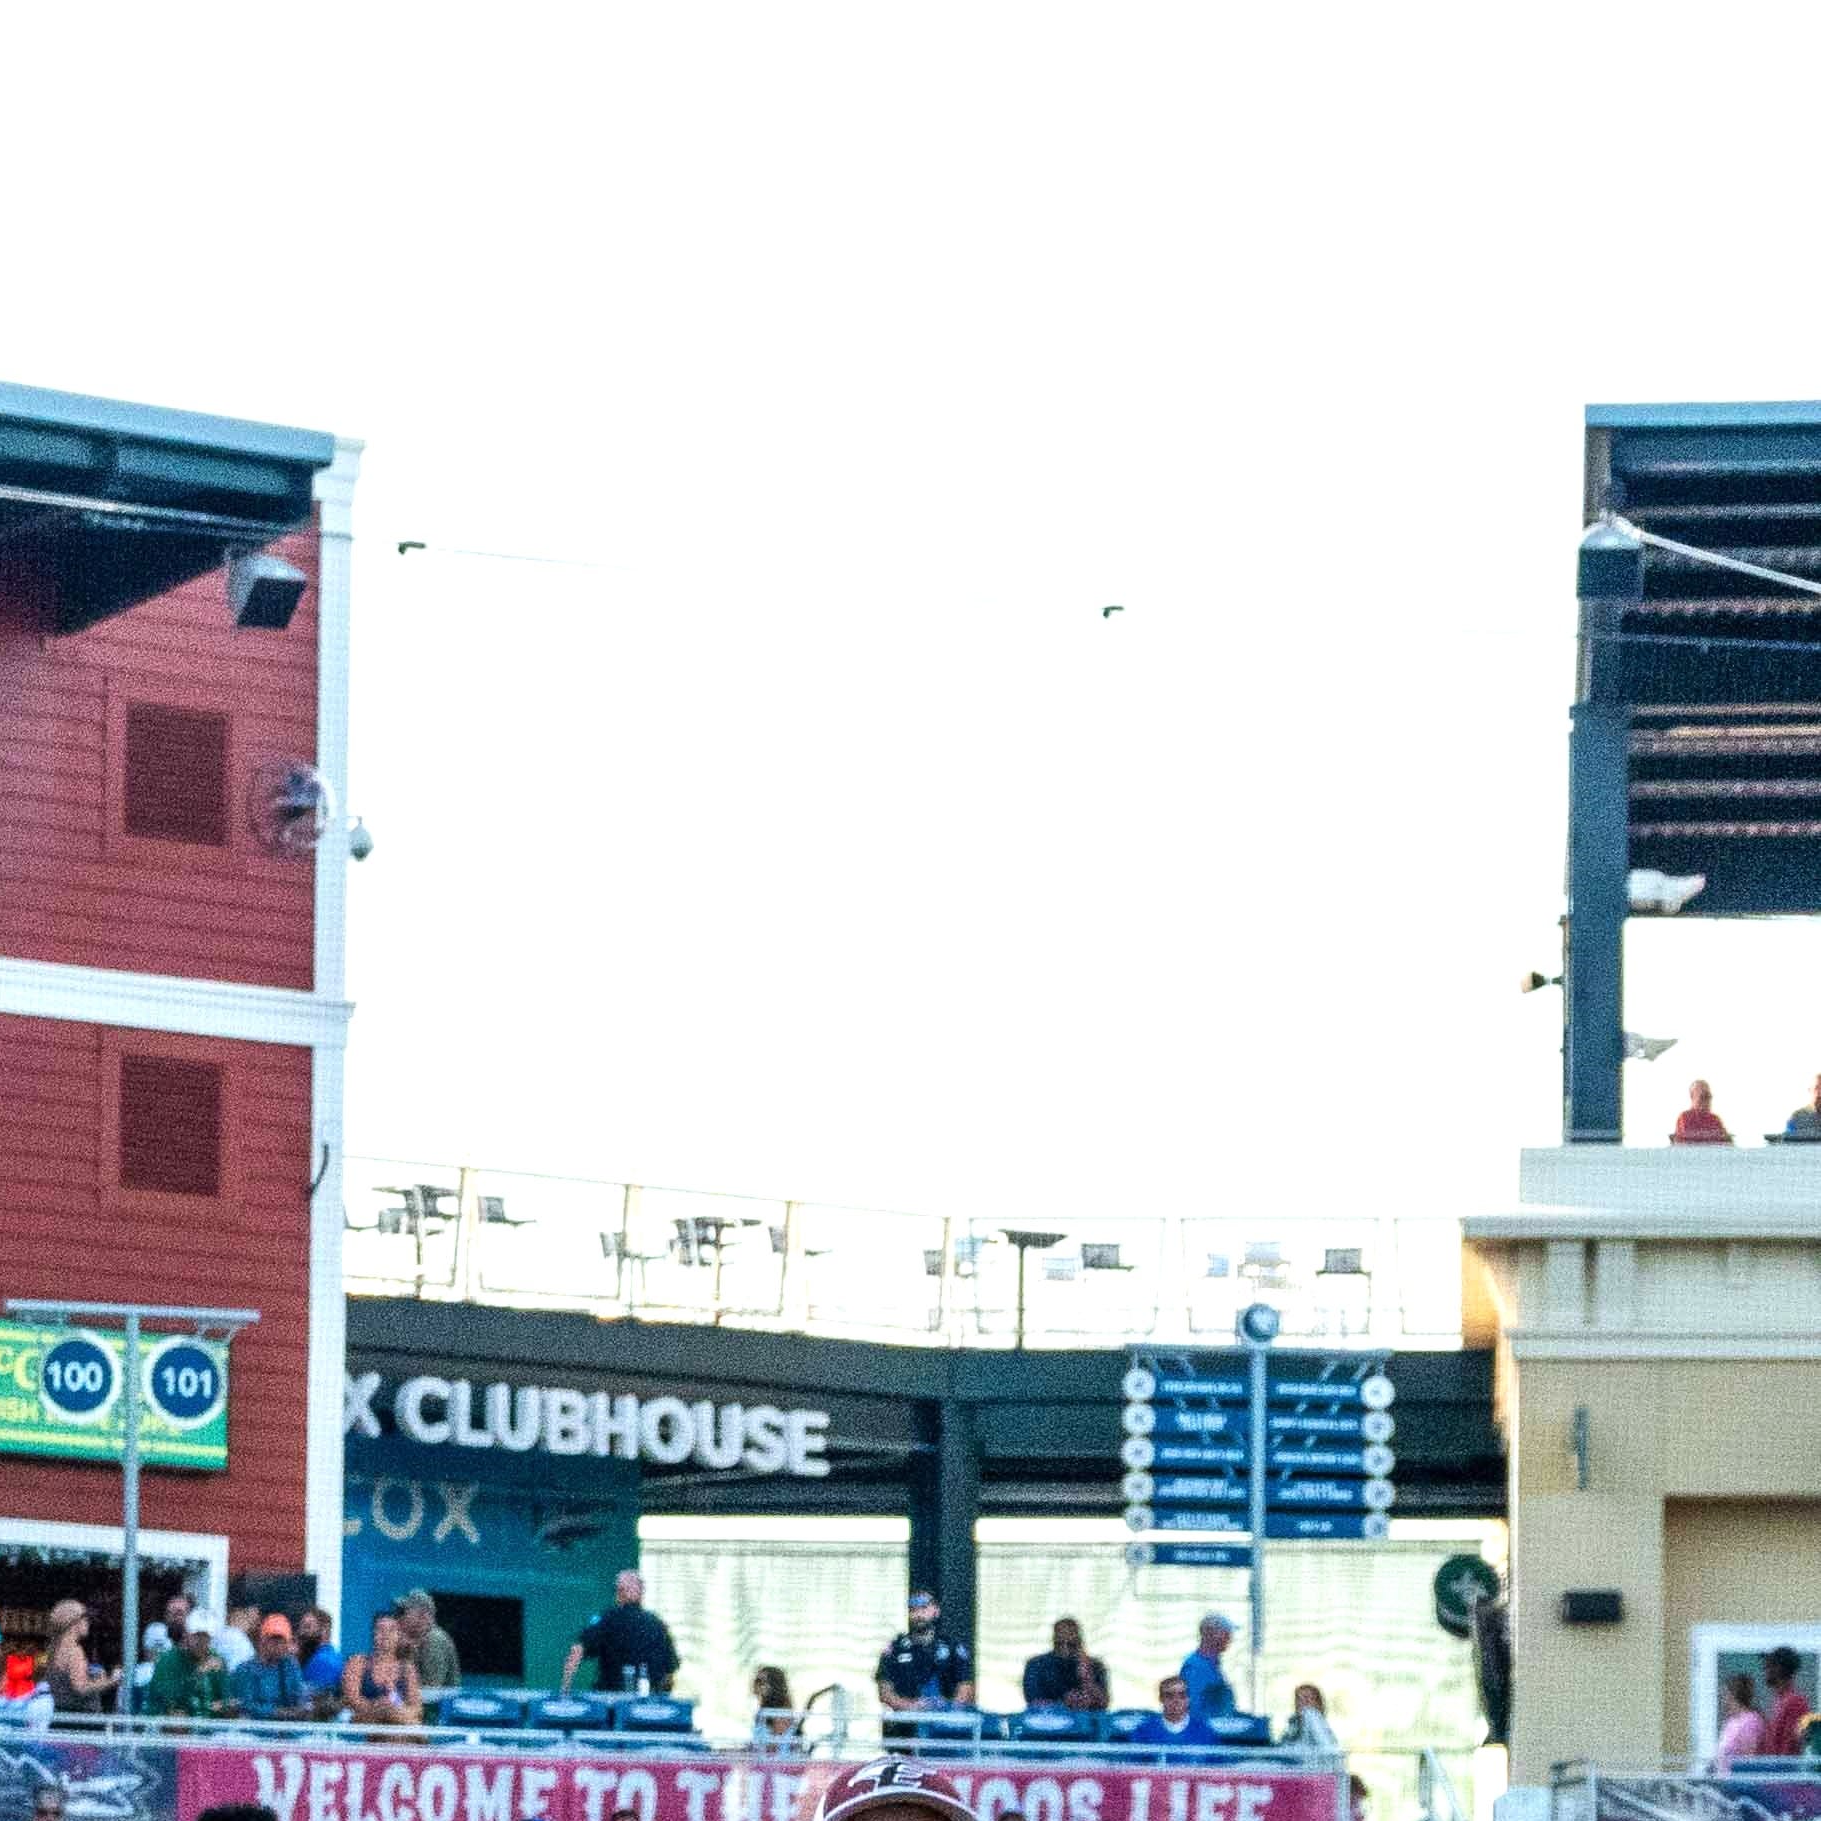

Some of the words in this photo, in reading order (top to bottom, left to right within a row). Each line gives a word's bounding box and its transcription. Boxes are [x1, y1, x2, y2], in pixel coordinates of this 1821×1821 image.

[46, 1360, 104, 1393] 100
[162, 1366, 213, 1399] 101
[396, 1375, 831, 1477] CLUBHOUSE
[345, 1476, 482, 1545] OX
